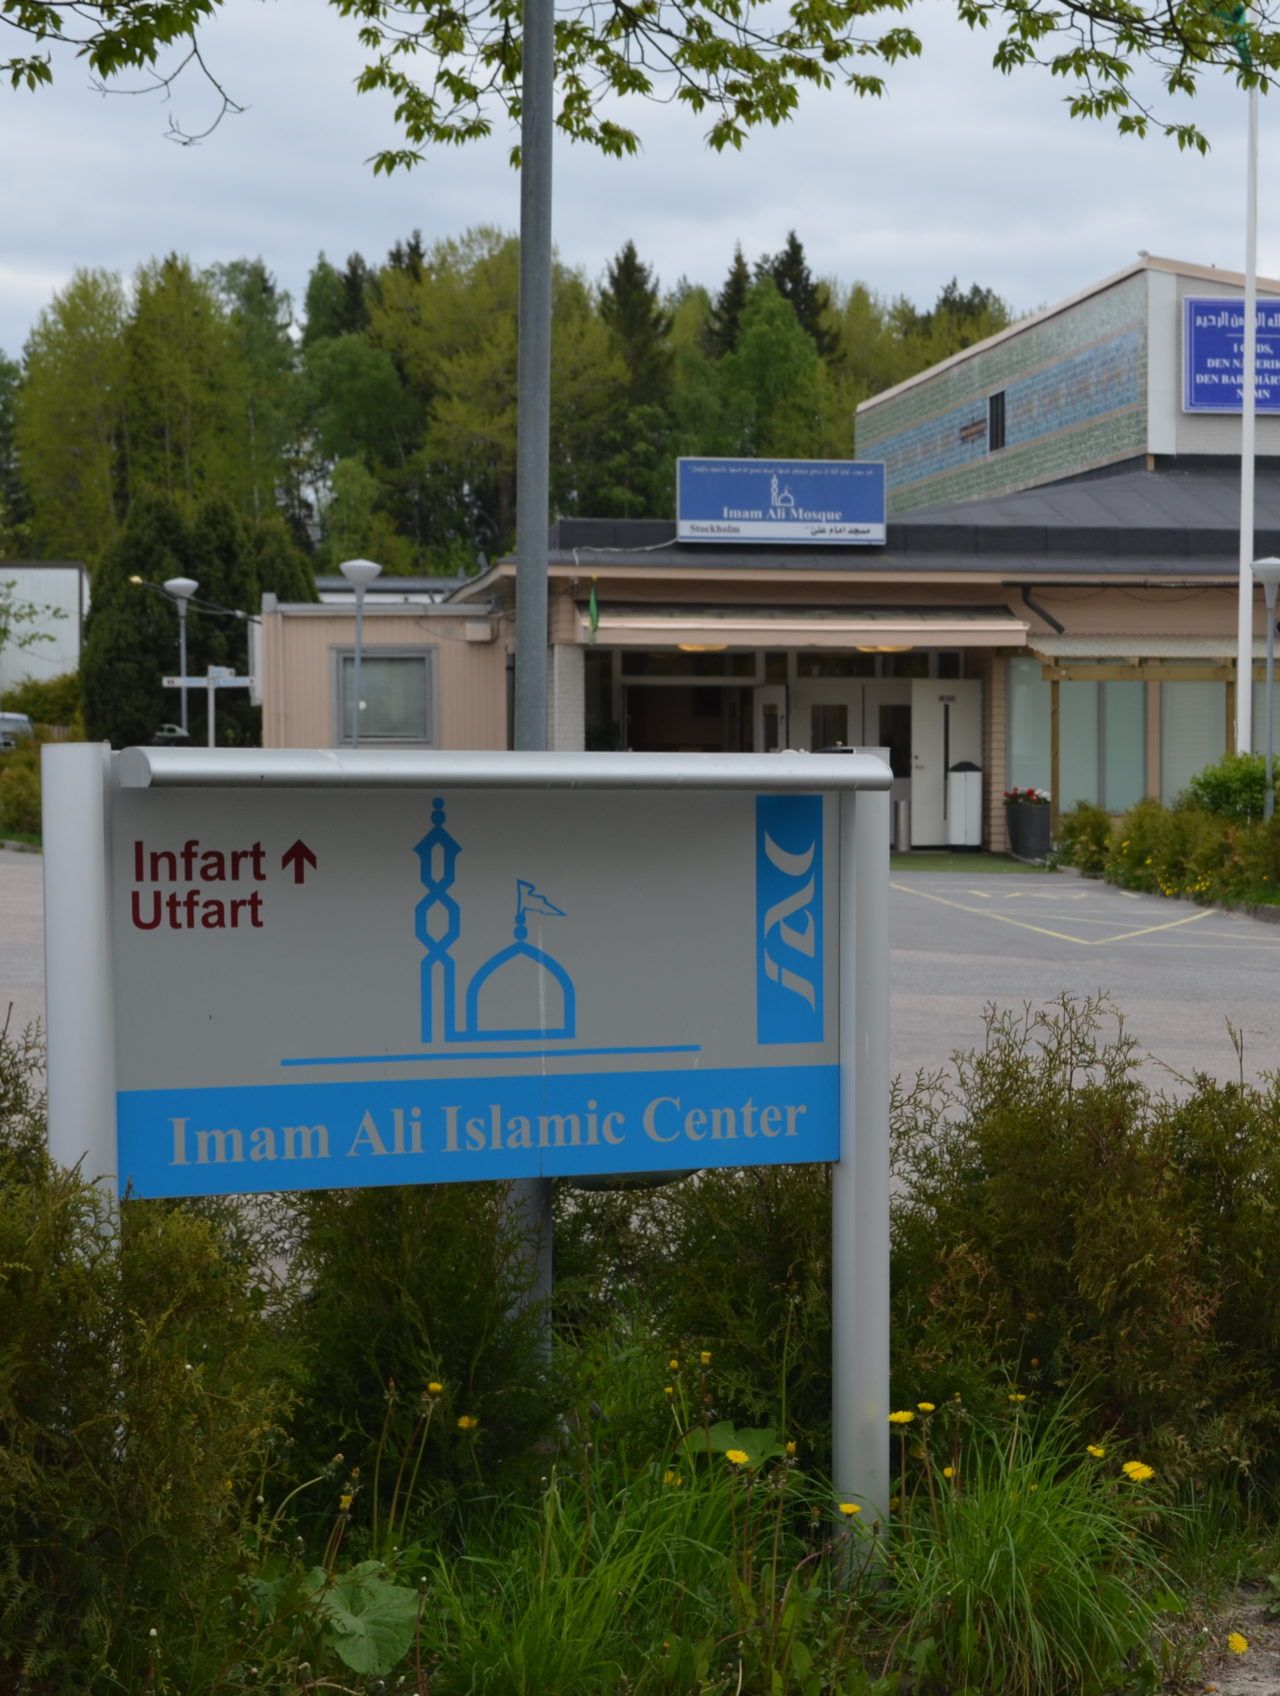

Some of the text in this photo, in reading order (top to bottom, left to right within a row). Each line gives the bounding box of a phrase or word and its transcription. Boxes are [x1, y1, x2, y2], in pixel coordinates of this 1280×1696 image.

[1206, 358, 1230, 368] DEN
[1195, 374, 1219, 384] DEN
[723, 506, 843, 523] Imam Ali Mosque
[690, 524, 741, 534] Stockholm
[134, 839, 267, 883] Infart
[131, 889, 264, 931] Utfart
[168, 1095, 808, 1166] Imam Ali Islamic Center
